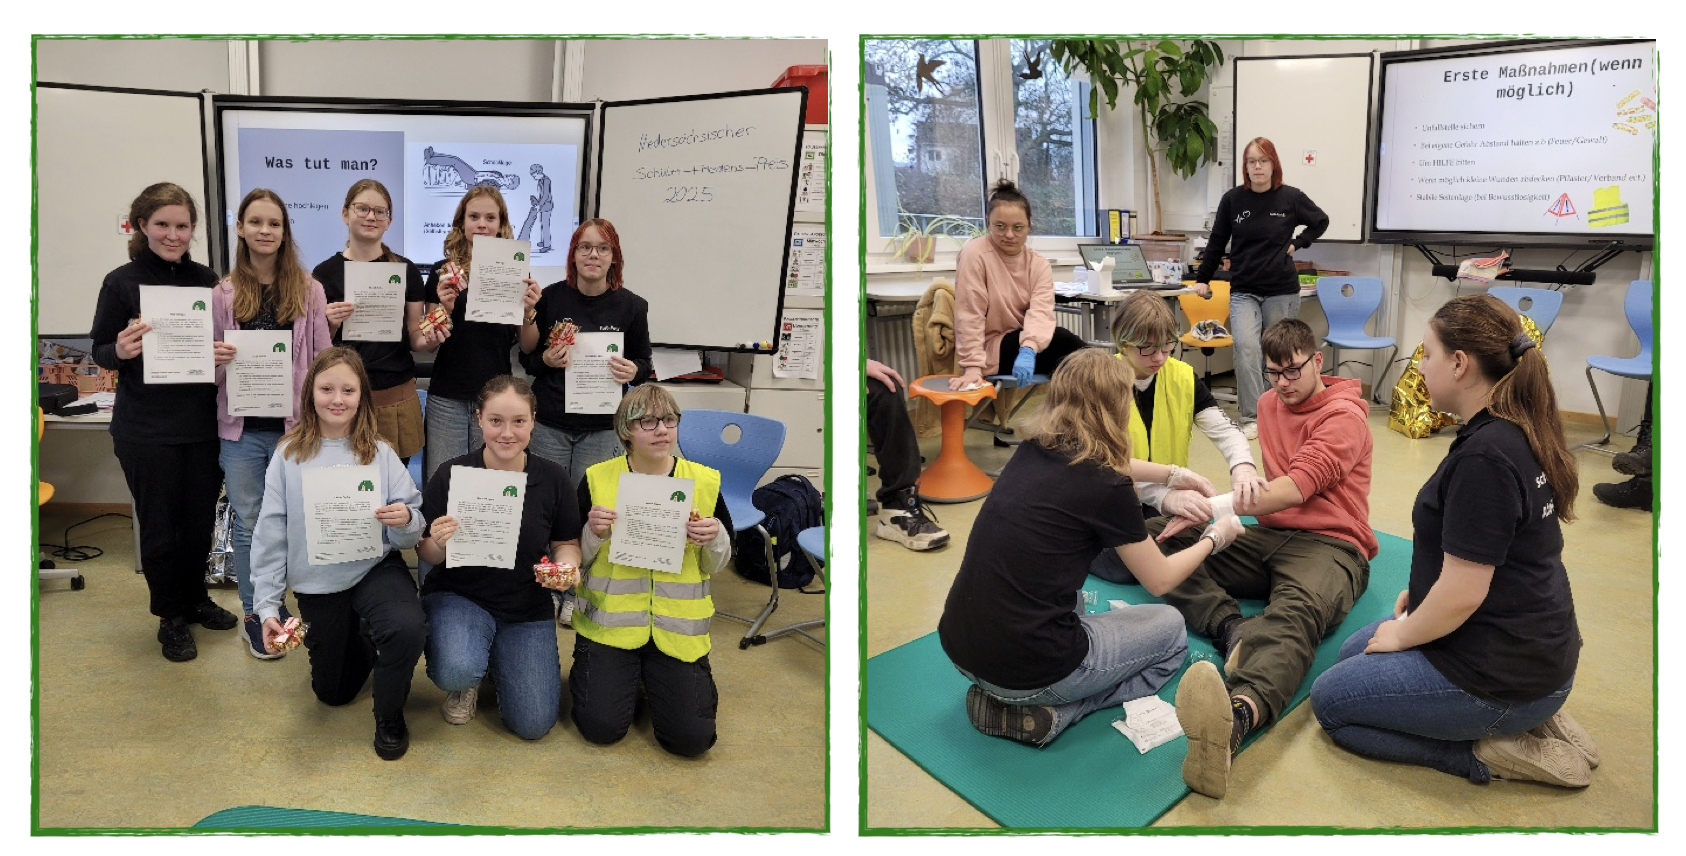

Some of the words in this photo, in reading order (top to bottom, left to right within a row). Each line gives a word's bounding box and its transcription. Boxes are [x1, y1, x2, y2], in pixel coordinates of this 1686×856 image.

[1443, 69, 1489, 83] Erste
[1498, 58, 1643, 79] Maßnahmen(wenn
[1496, 81, 1574, 100] möglich)
[264, 156, 294, 169] Was
[304, 157, 331, 170] tut
[341, 158, 379, 171] man?
[1432, 159, 1455, 167] HILFE
[663, 185, 718, 203] 2025
